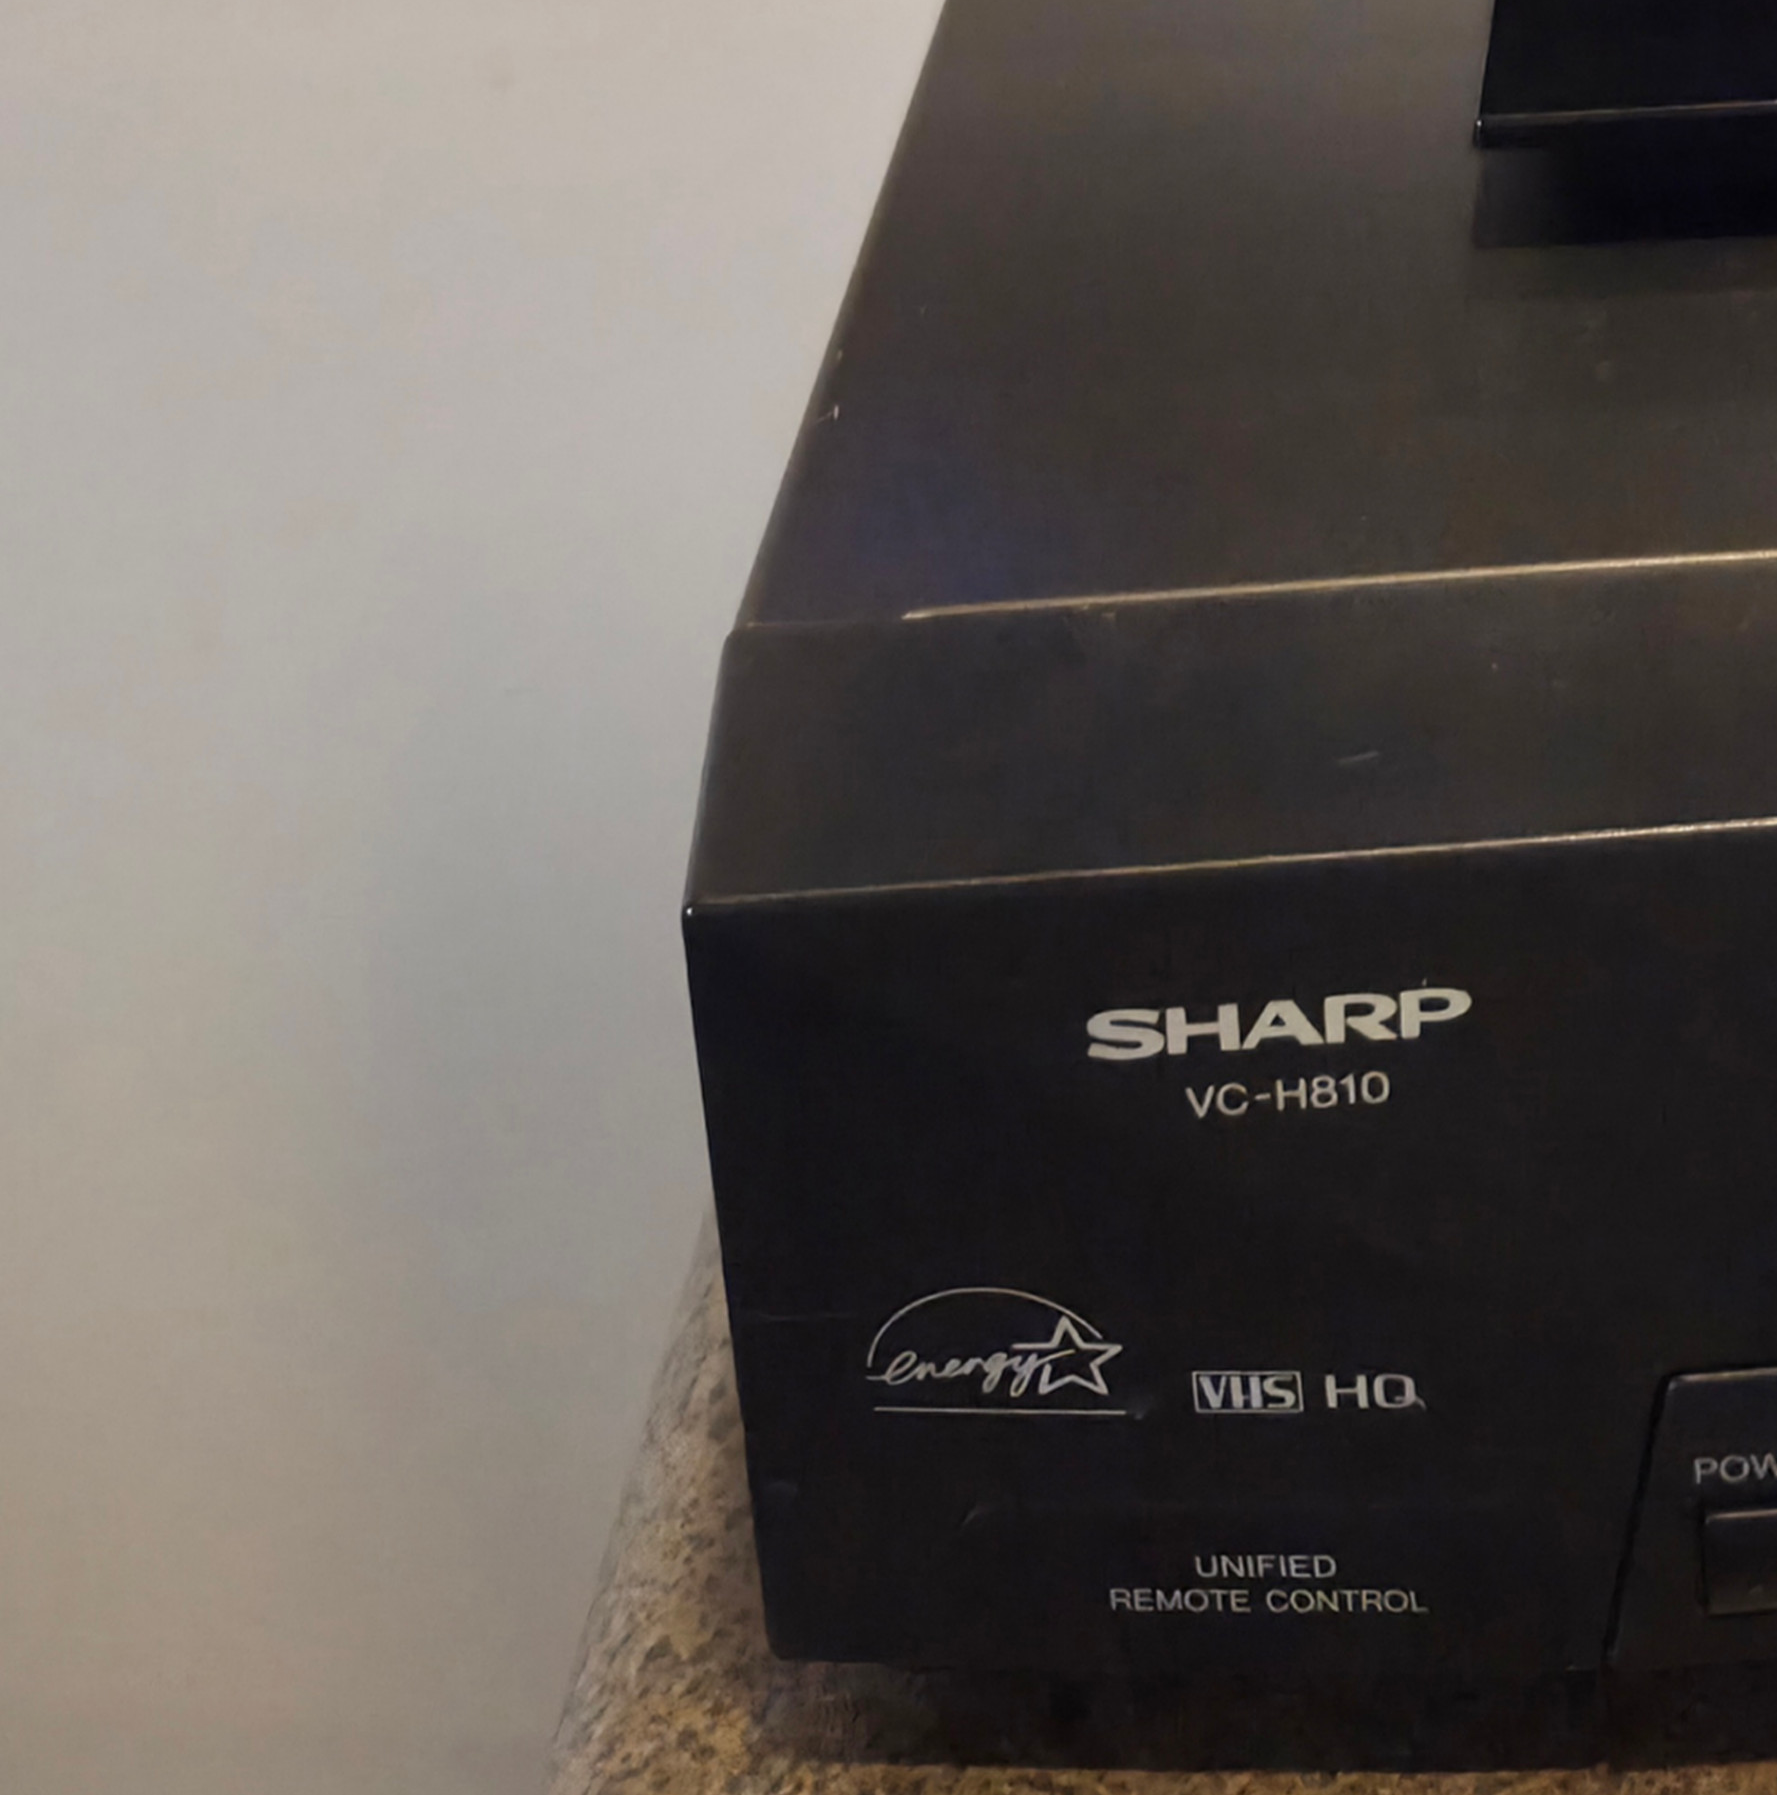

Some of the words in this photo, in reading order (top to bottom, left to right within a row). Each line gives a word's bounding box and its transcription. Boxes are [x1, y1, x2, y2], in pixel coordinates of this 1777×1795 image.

[1086, 987, 1472, 1061] SHARP
[1185, 1070, 1390, 1119] VC-H810
[882, 1344, 1044, 1398] energy
[1195, 1372, 1302, 1413] VHS
[1324, 1374, 1425, 1409] HQ
[1194, 1554, 1337, 1578] UNIFIED
[1109, 1588, 1251, 1613] REMOTE
[1265, 1589, 1427, 1614] CONTROL
